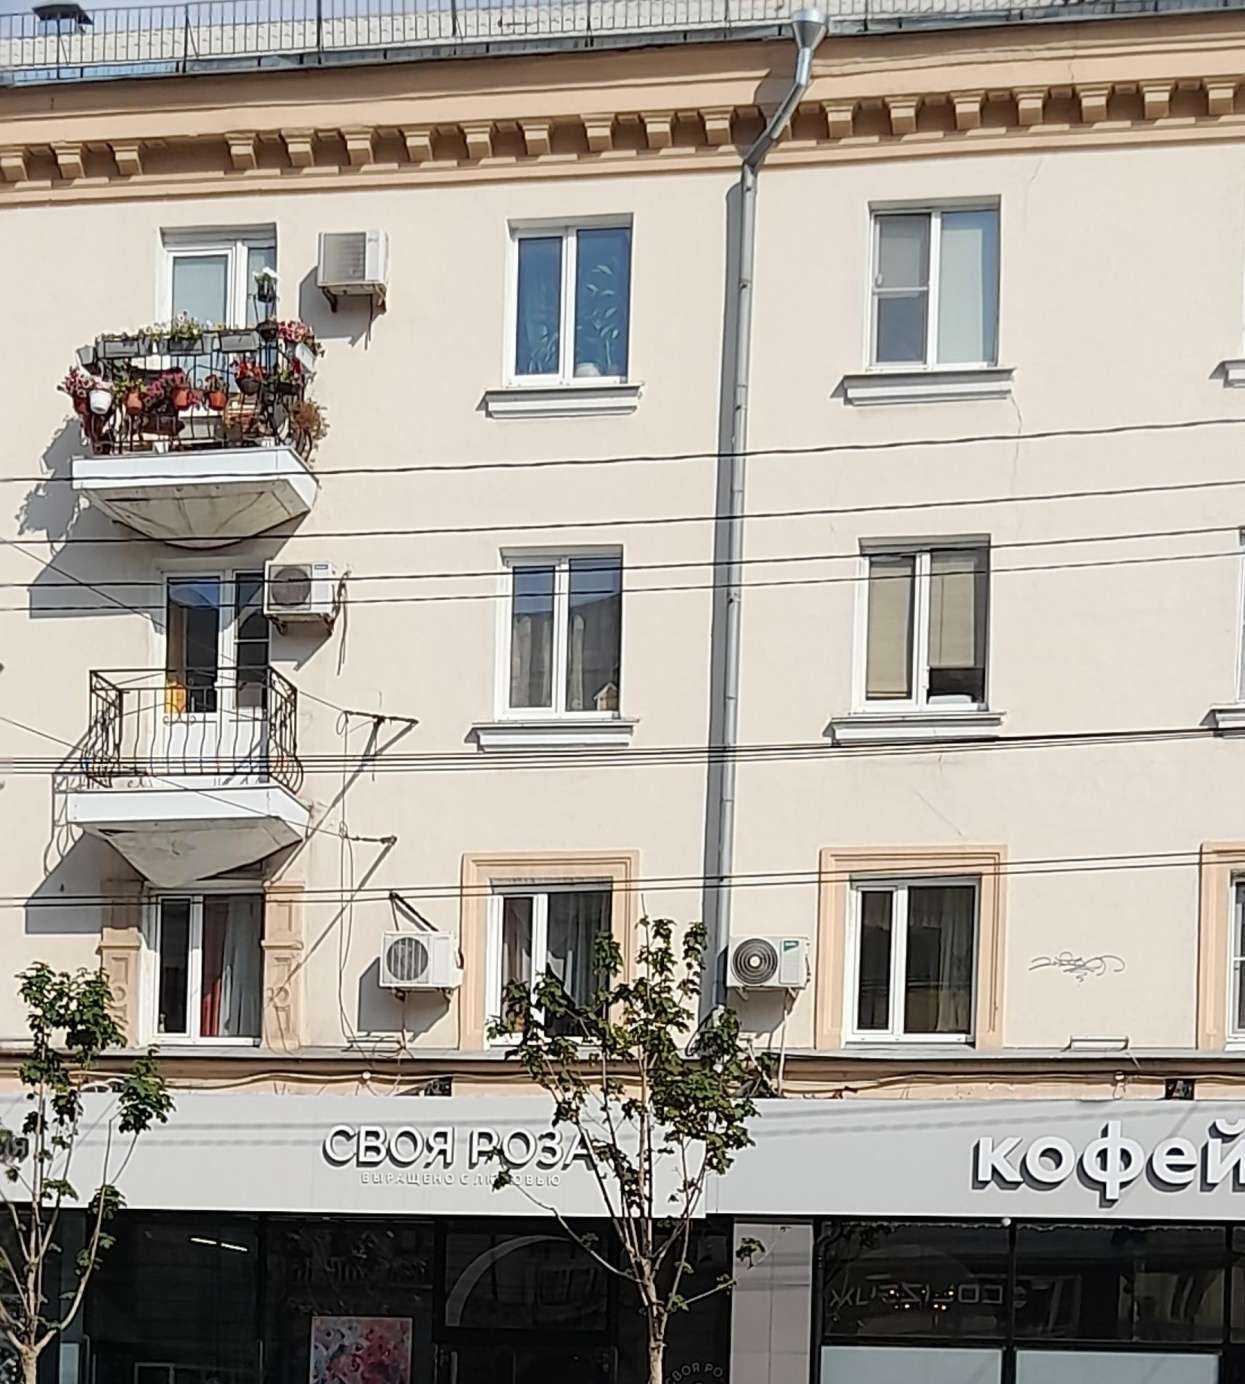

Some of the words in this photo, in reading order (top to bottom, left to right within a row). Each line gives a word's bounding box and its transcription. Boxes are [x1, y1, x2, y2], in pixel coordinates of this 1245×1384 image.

[322, 1125, 454, 1169] СВОЯ
[468, 1127, 597, 1171] РОЗА
[972, 1119, 1245, 1209] кофей
[361, 1171, 454, 1187] ВЫРАЩЕНО
[474, 1172, 561, 1187] ЛЮОВЬЮ
